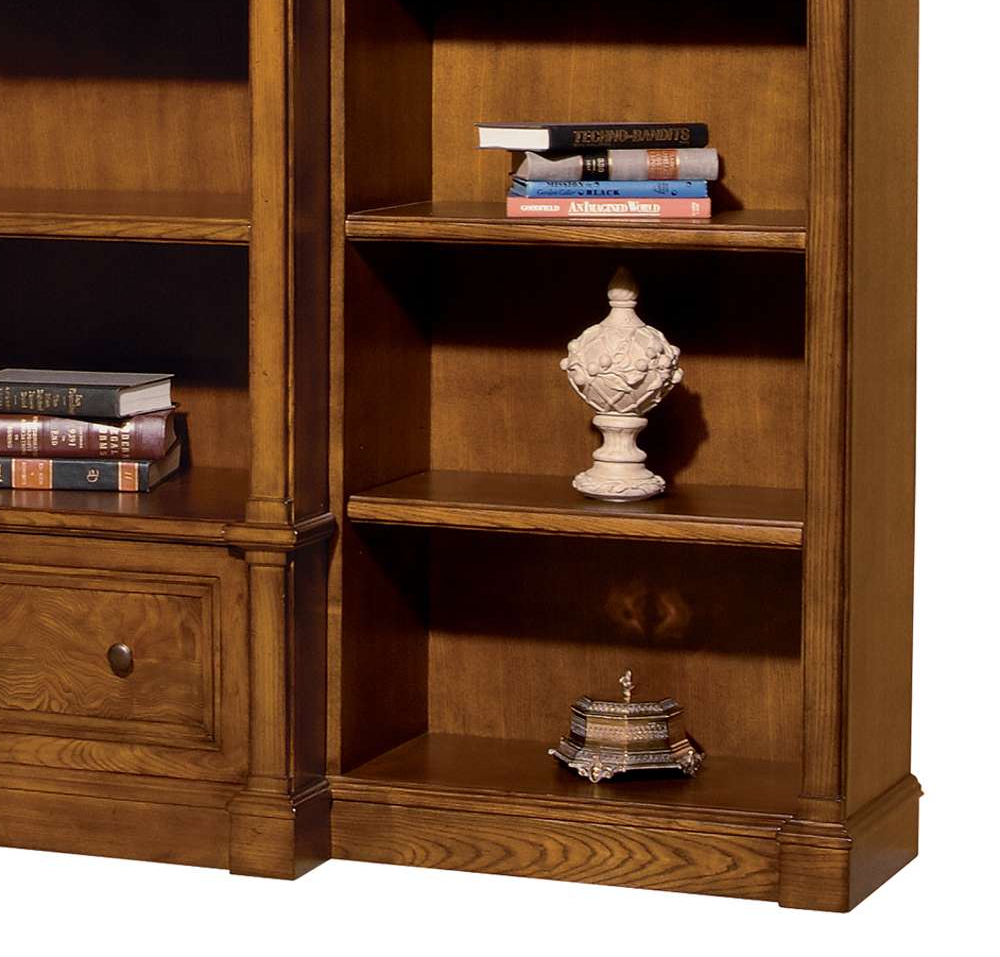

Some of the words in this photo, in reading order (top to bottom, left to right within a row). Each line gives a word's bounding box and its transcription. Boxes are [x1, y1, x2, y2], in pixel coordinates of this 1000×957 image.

[572, 127, 691, 146] TECHNO-BANDITS
[568, 202, 584, 212] AN
[628, 200, 661, 213] WORLD
